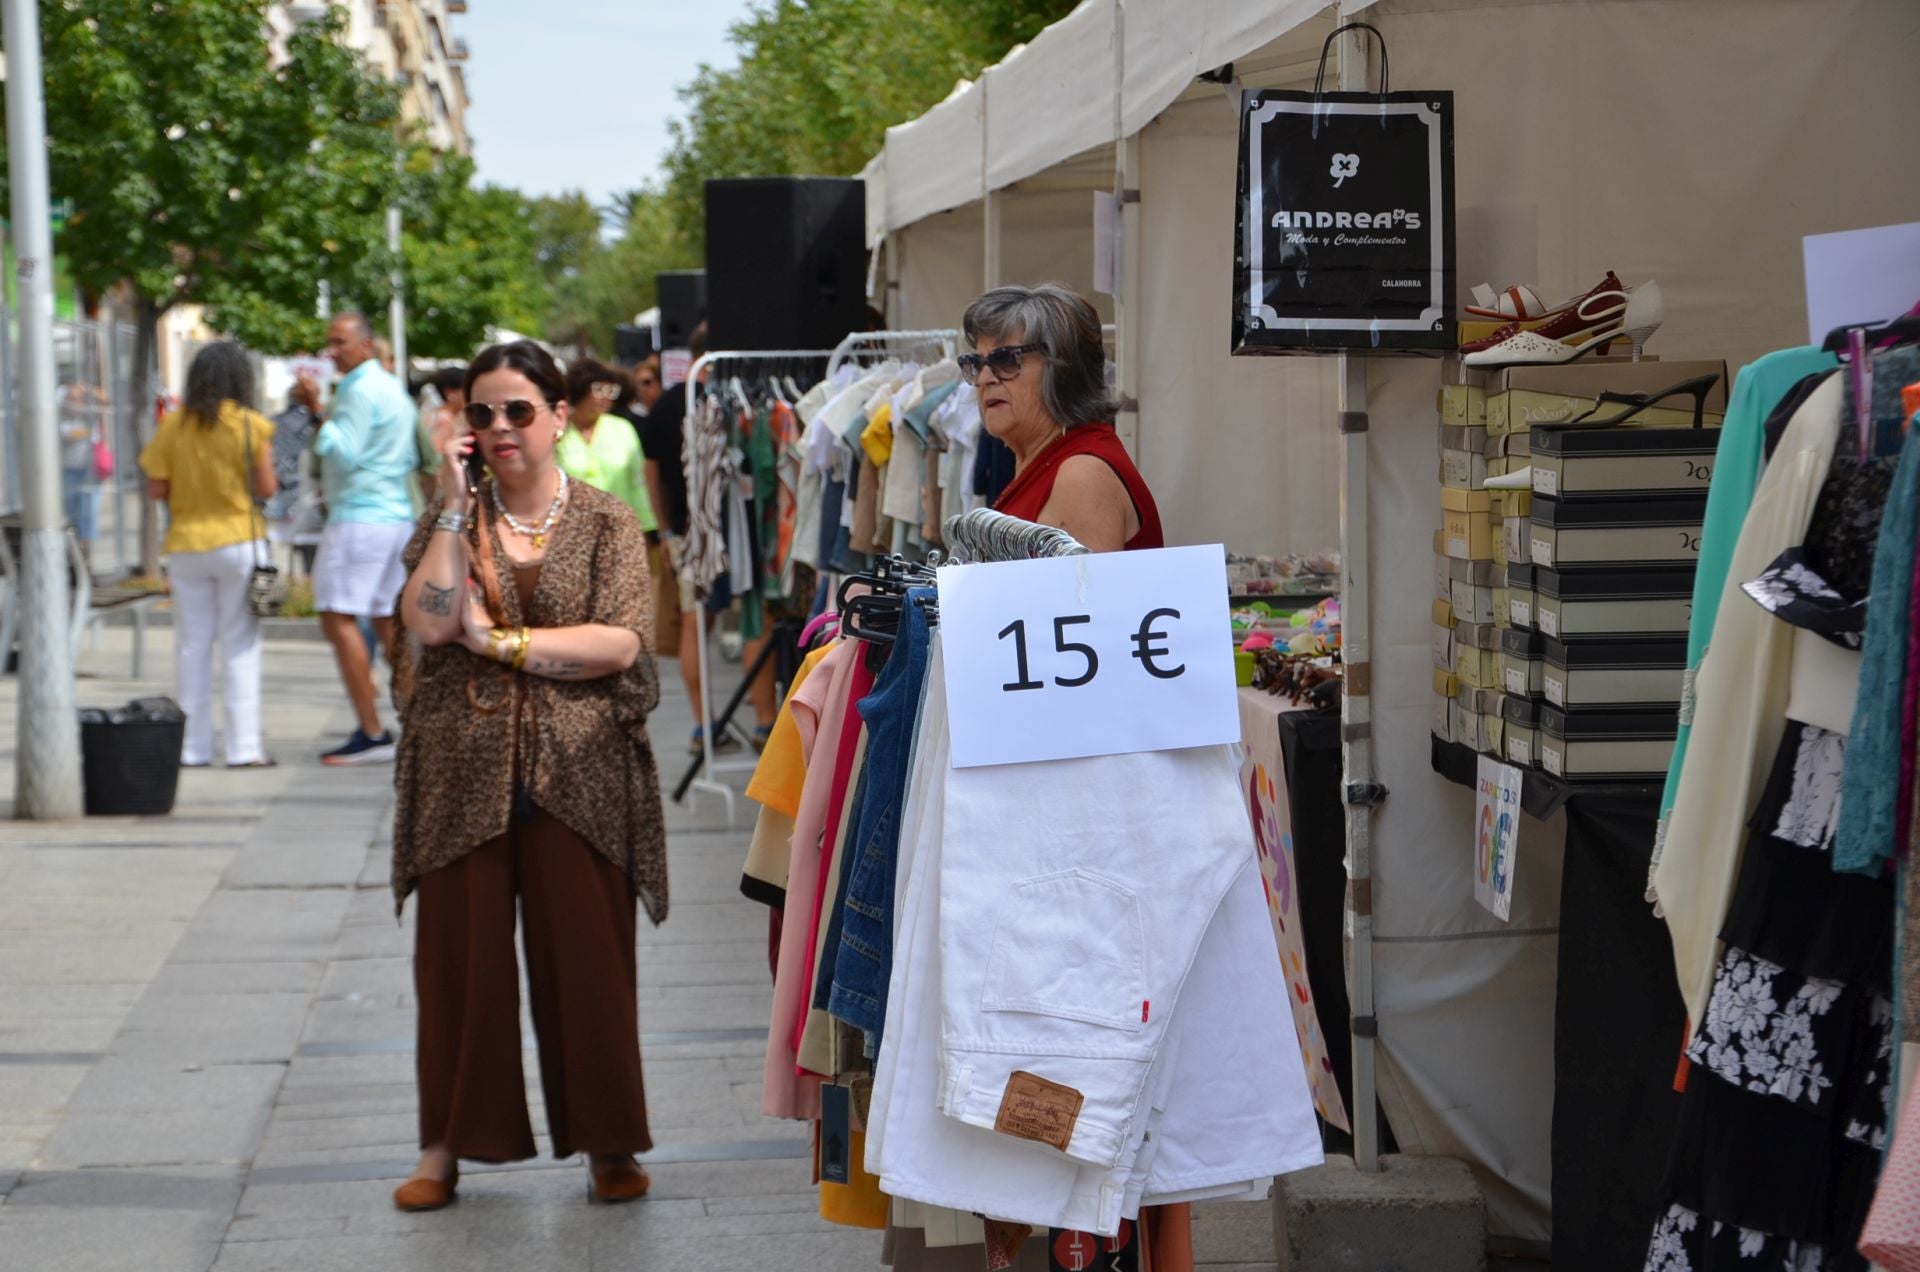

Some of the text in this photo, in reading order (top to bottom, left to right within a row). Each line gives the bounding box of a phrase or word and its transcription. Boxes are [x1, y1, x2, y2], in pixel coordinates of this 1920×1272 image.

[1285, 232, 1407, 247] Moda y Complementos
[1381, 279, 1422, 288] CALAHORRA
[997, 607, 1186, 692] 15 €
